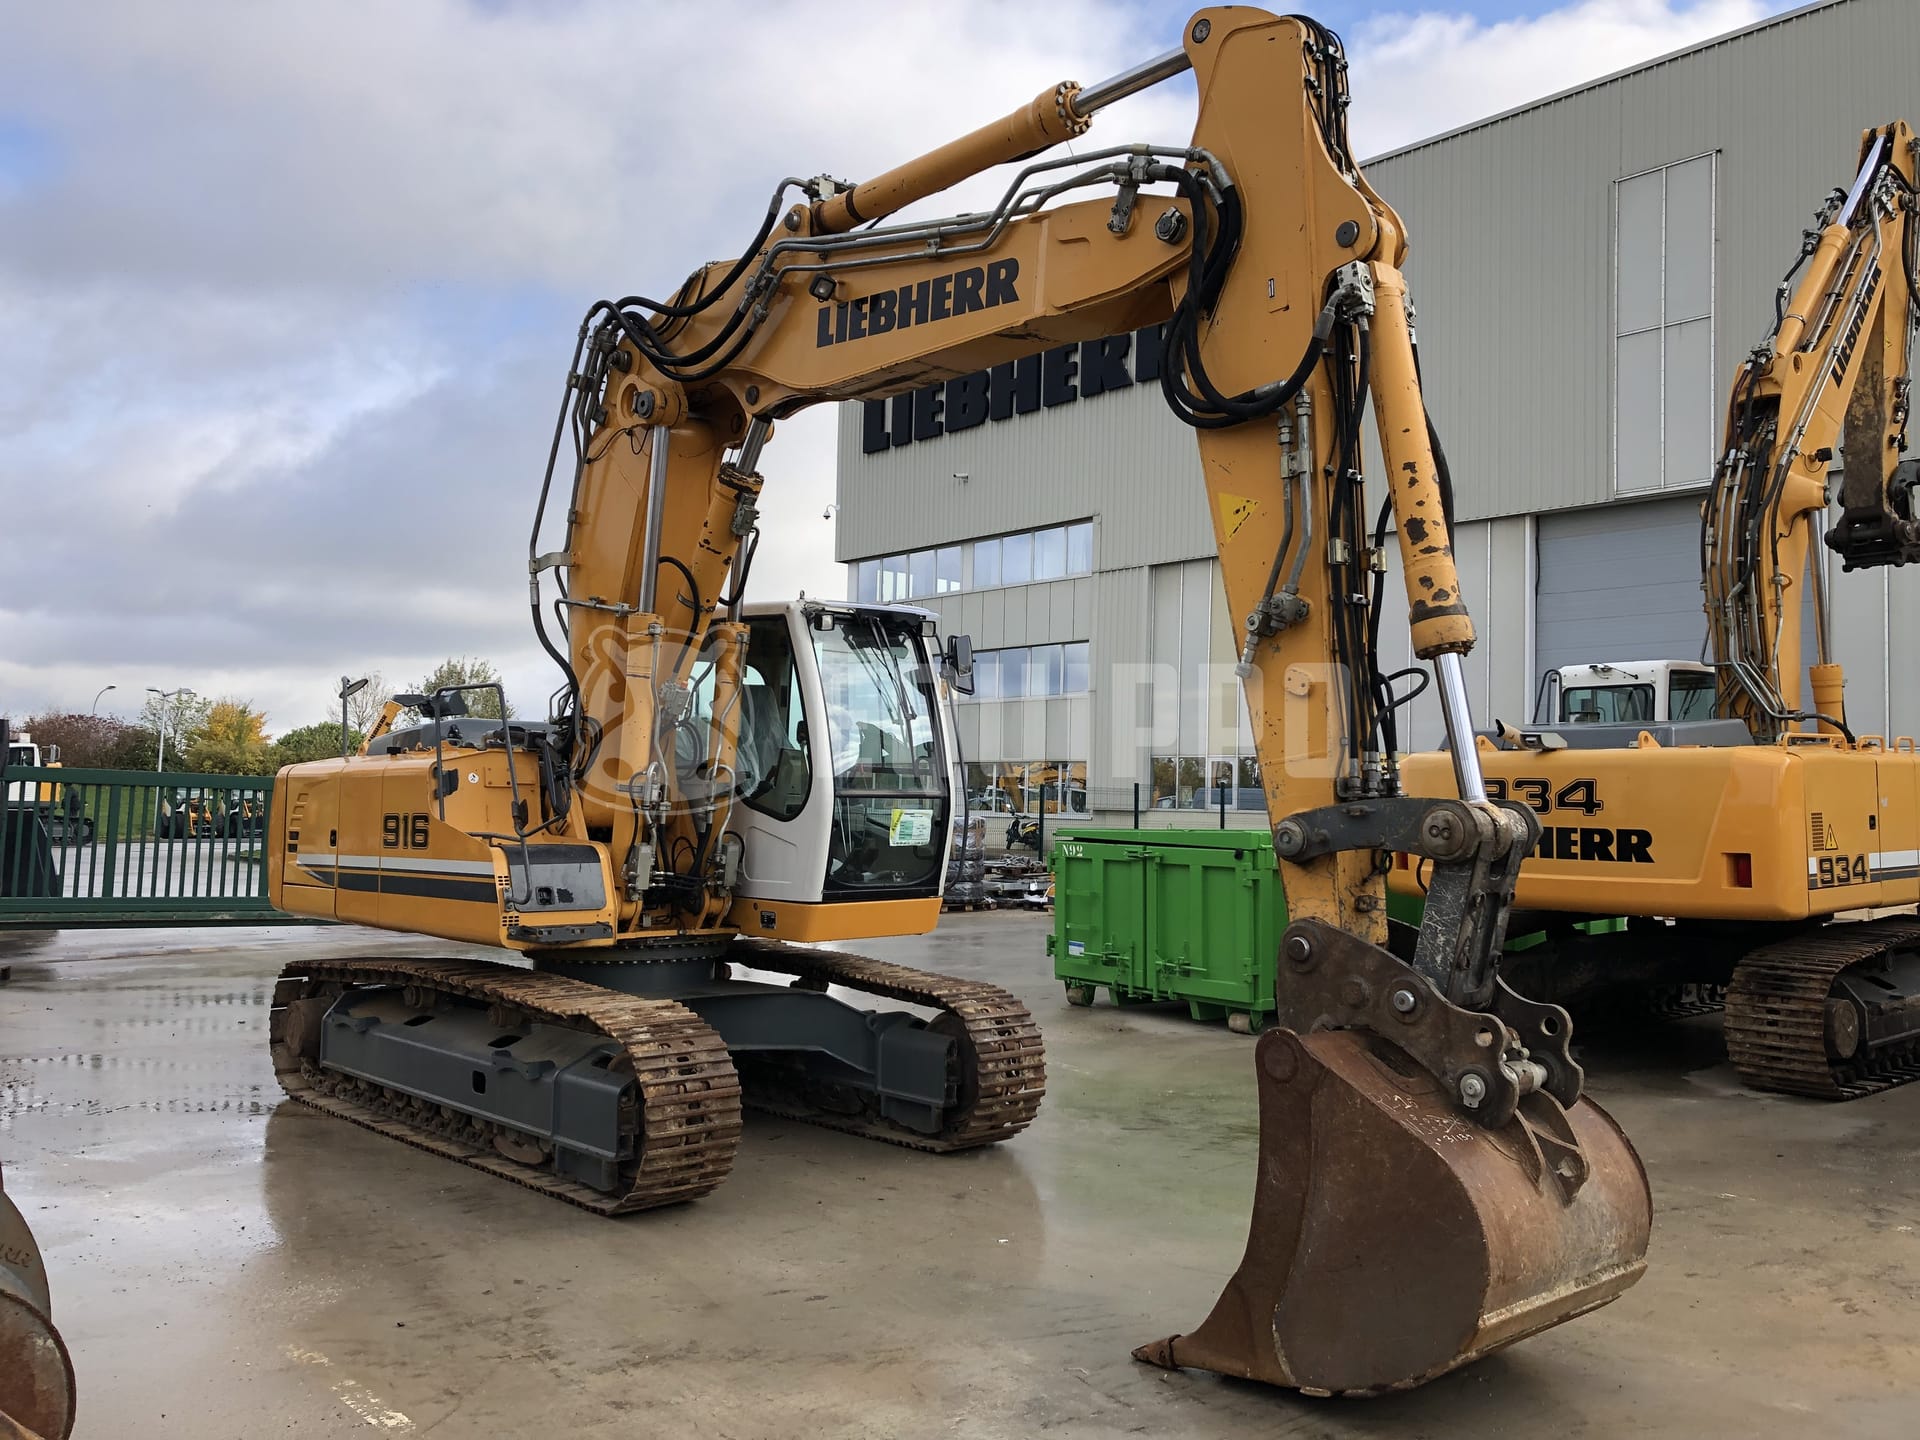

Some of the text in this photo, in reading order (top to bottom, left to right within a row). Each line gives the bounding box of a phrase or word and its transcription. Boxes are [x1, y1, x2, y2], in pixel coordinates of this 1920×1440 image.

[816, 257, 1020, 348] LIEBHERR
[383, 812, 429, 849] 916
[1819, 854, 1868, 885] 934
